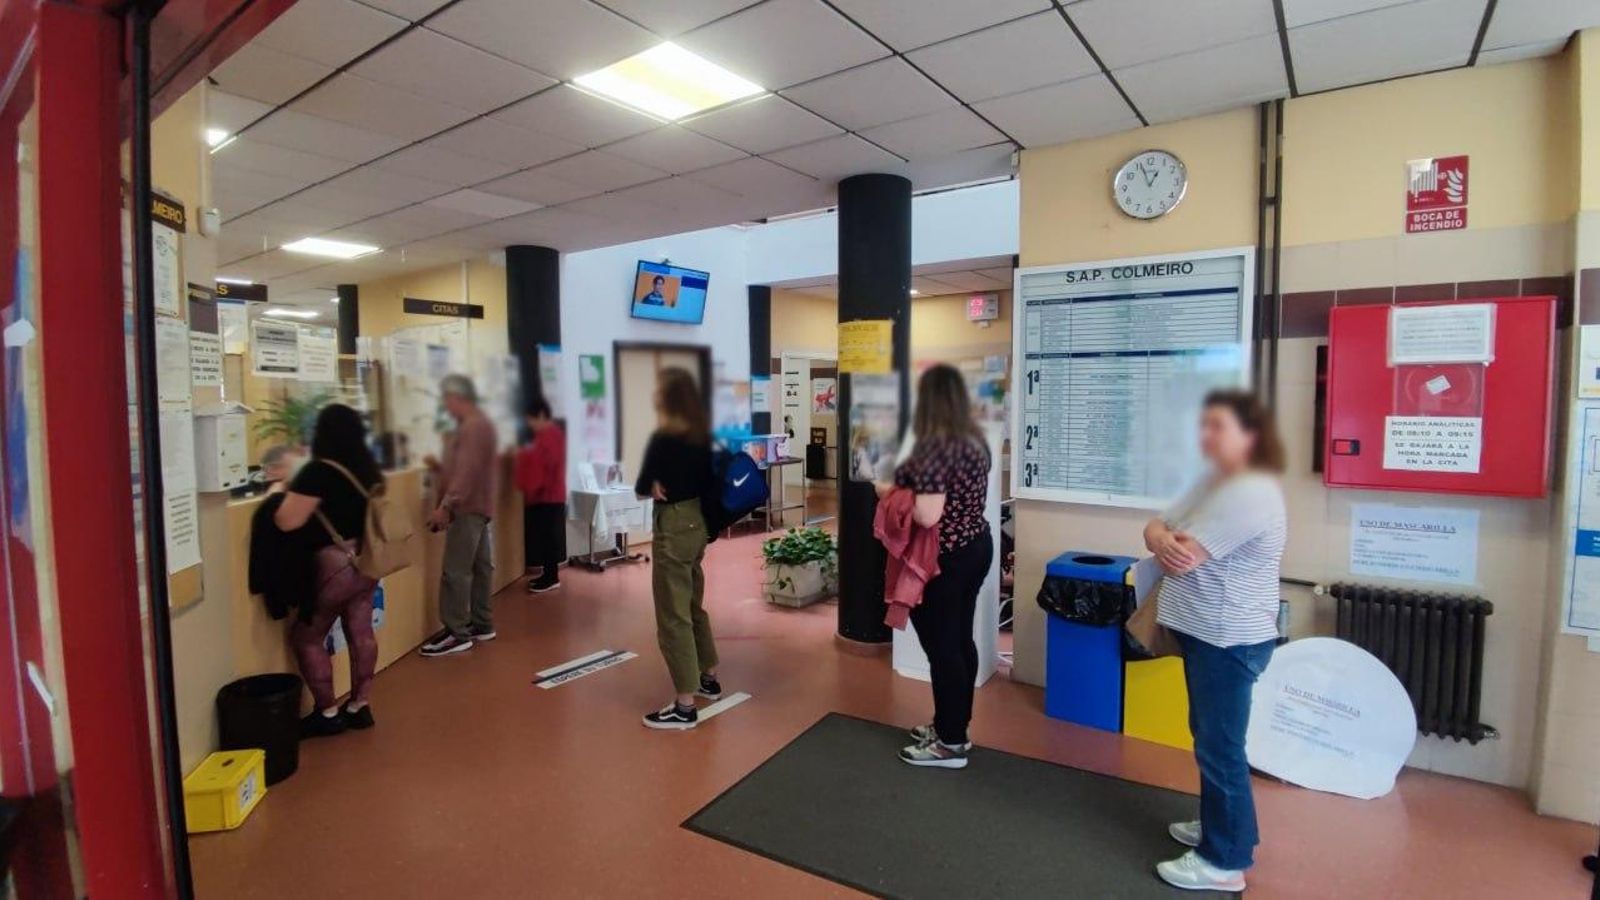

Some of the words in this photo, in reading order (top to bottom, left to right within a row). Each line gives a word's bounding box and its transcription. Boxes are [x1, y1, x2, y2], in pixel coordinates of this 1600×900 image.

[1413, 212, 1443, 222] BOCA
[1445, 210, 1460, 220] DE
[1410, 219, 1462, 231] INCENDIO
[1066, 268, 1105, 284] S.A.P.
[1111, 262, 1194, 280] COLMEIRO
[432, 302, 459, 314] CITAS
